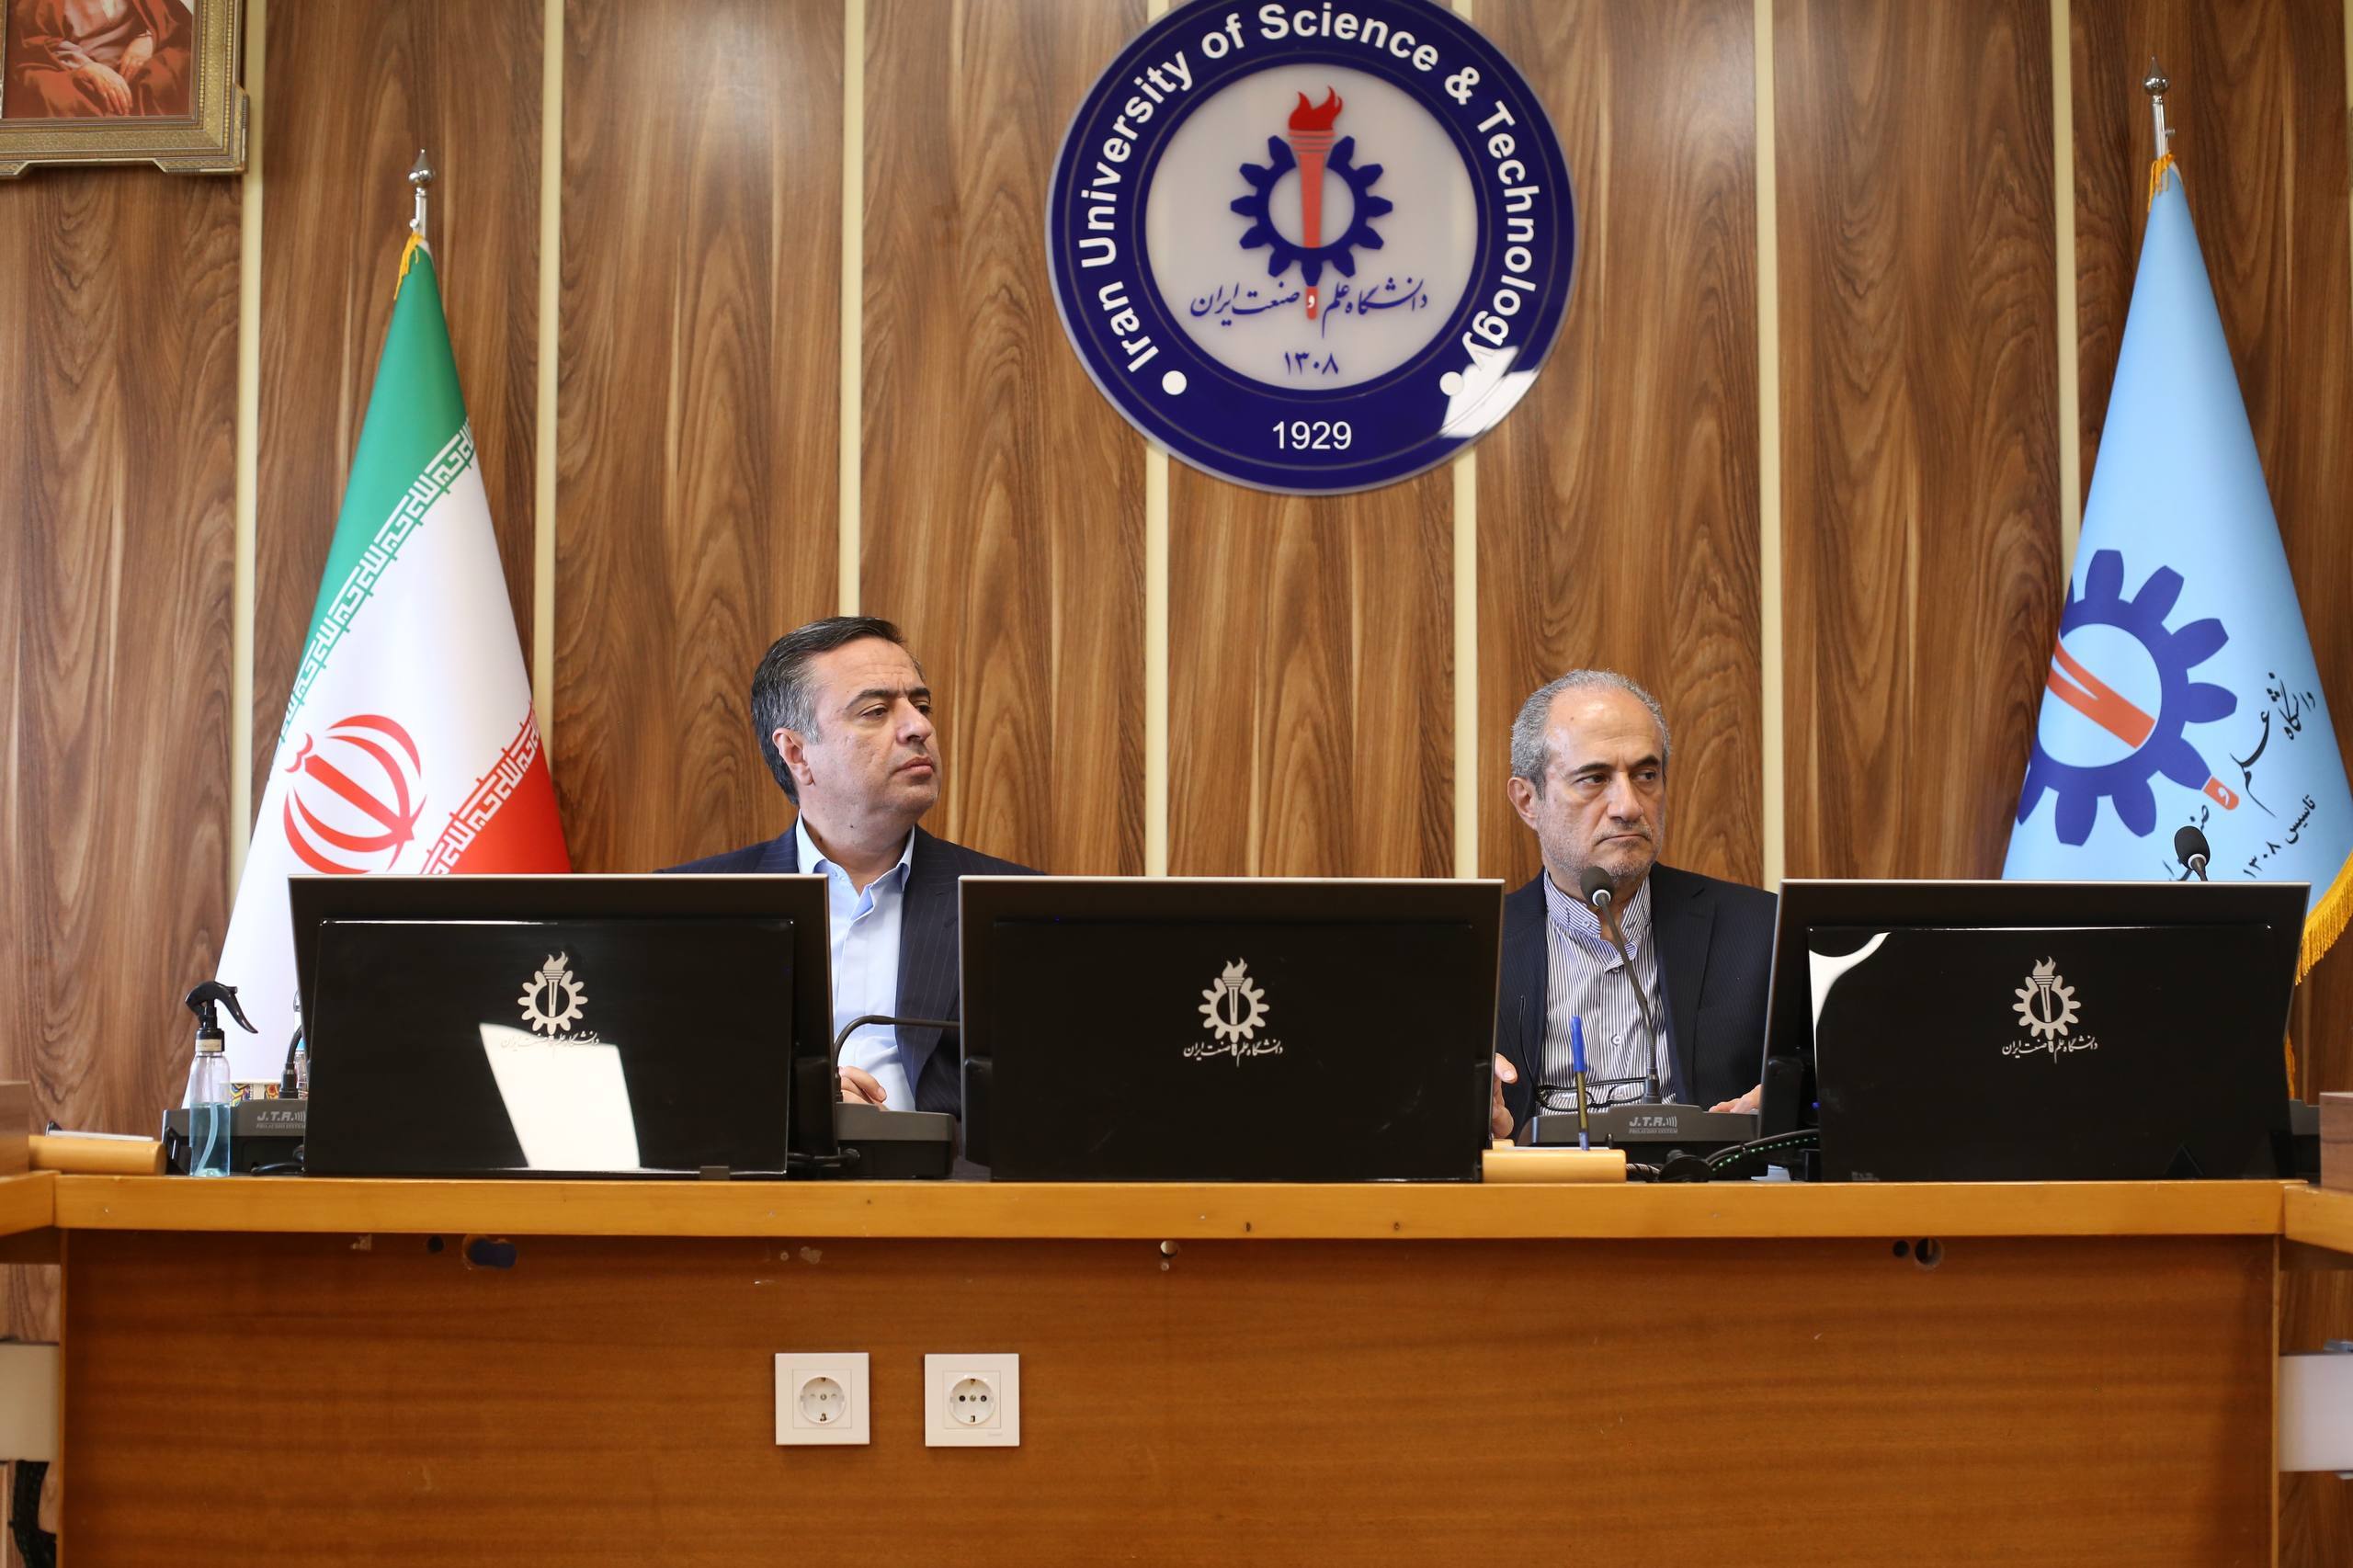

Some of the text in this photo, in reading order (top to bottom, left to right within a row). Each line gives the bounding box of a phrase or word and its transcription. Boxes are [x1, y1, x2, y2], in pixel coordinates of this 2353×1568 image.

[1079, 2, 1540, 372] Iran University of Science & Technology
[1190, 282, 1240, 326] ایران
[1232, 281, 1301, 315] صنعت
[1322, 281, 1350, 338] علم
[1346, 278, 1427, 315] دانشگاه
[1273, 420, 1351, 449] 1929
[1246, 1039, 1283, 1056] دانشگاه
[2063, 1035, 2097, 1052] دانشگاه
